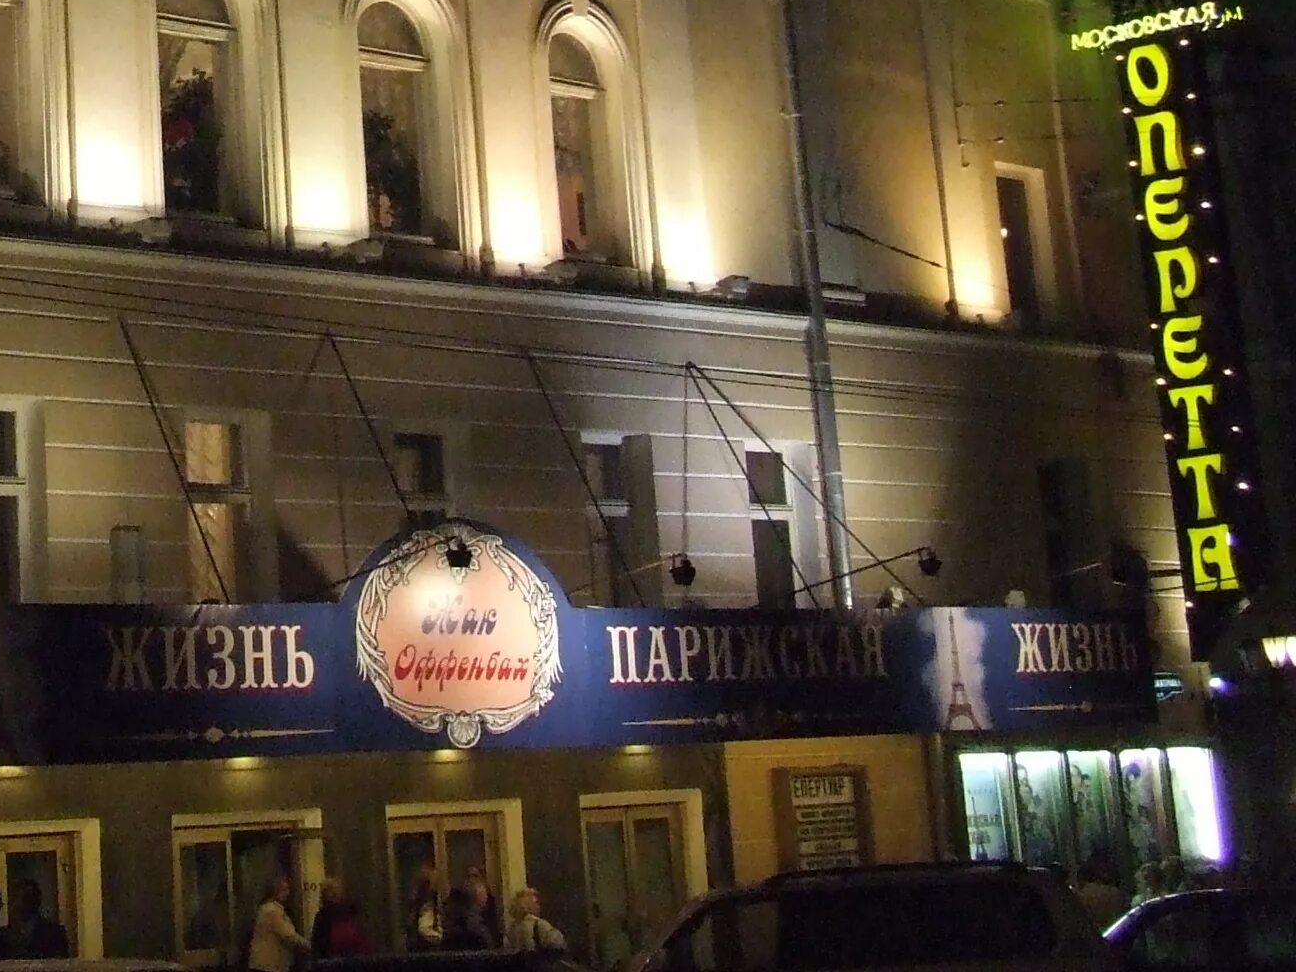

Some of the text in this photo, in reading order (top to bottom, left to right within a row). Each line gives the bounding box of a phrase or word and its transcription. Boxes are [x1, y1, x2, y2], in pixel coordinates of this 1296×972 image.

[1071, 2, 1217, 50] МОСКОВСКАЯ
[105, 625, 316, 691] ЖИЗНЬ
[394, 644, 528, 692] Оффенбах
[606, 622, 1140, 684] ПАРИЖСКАЯ ЖИЗНЬ
